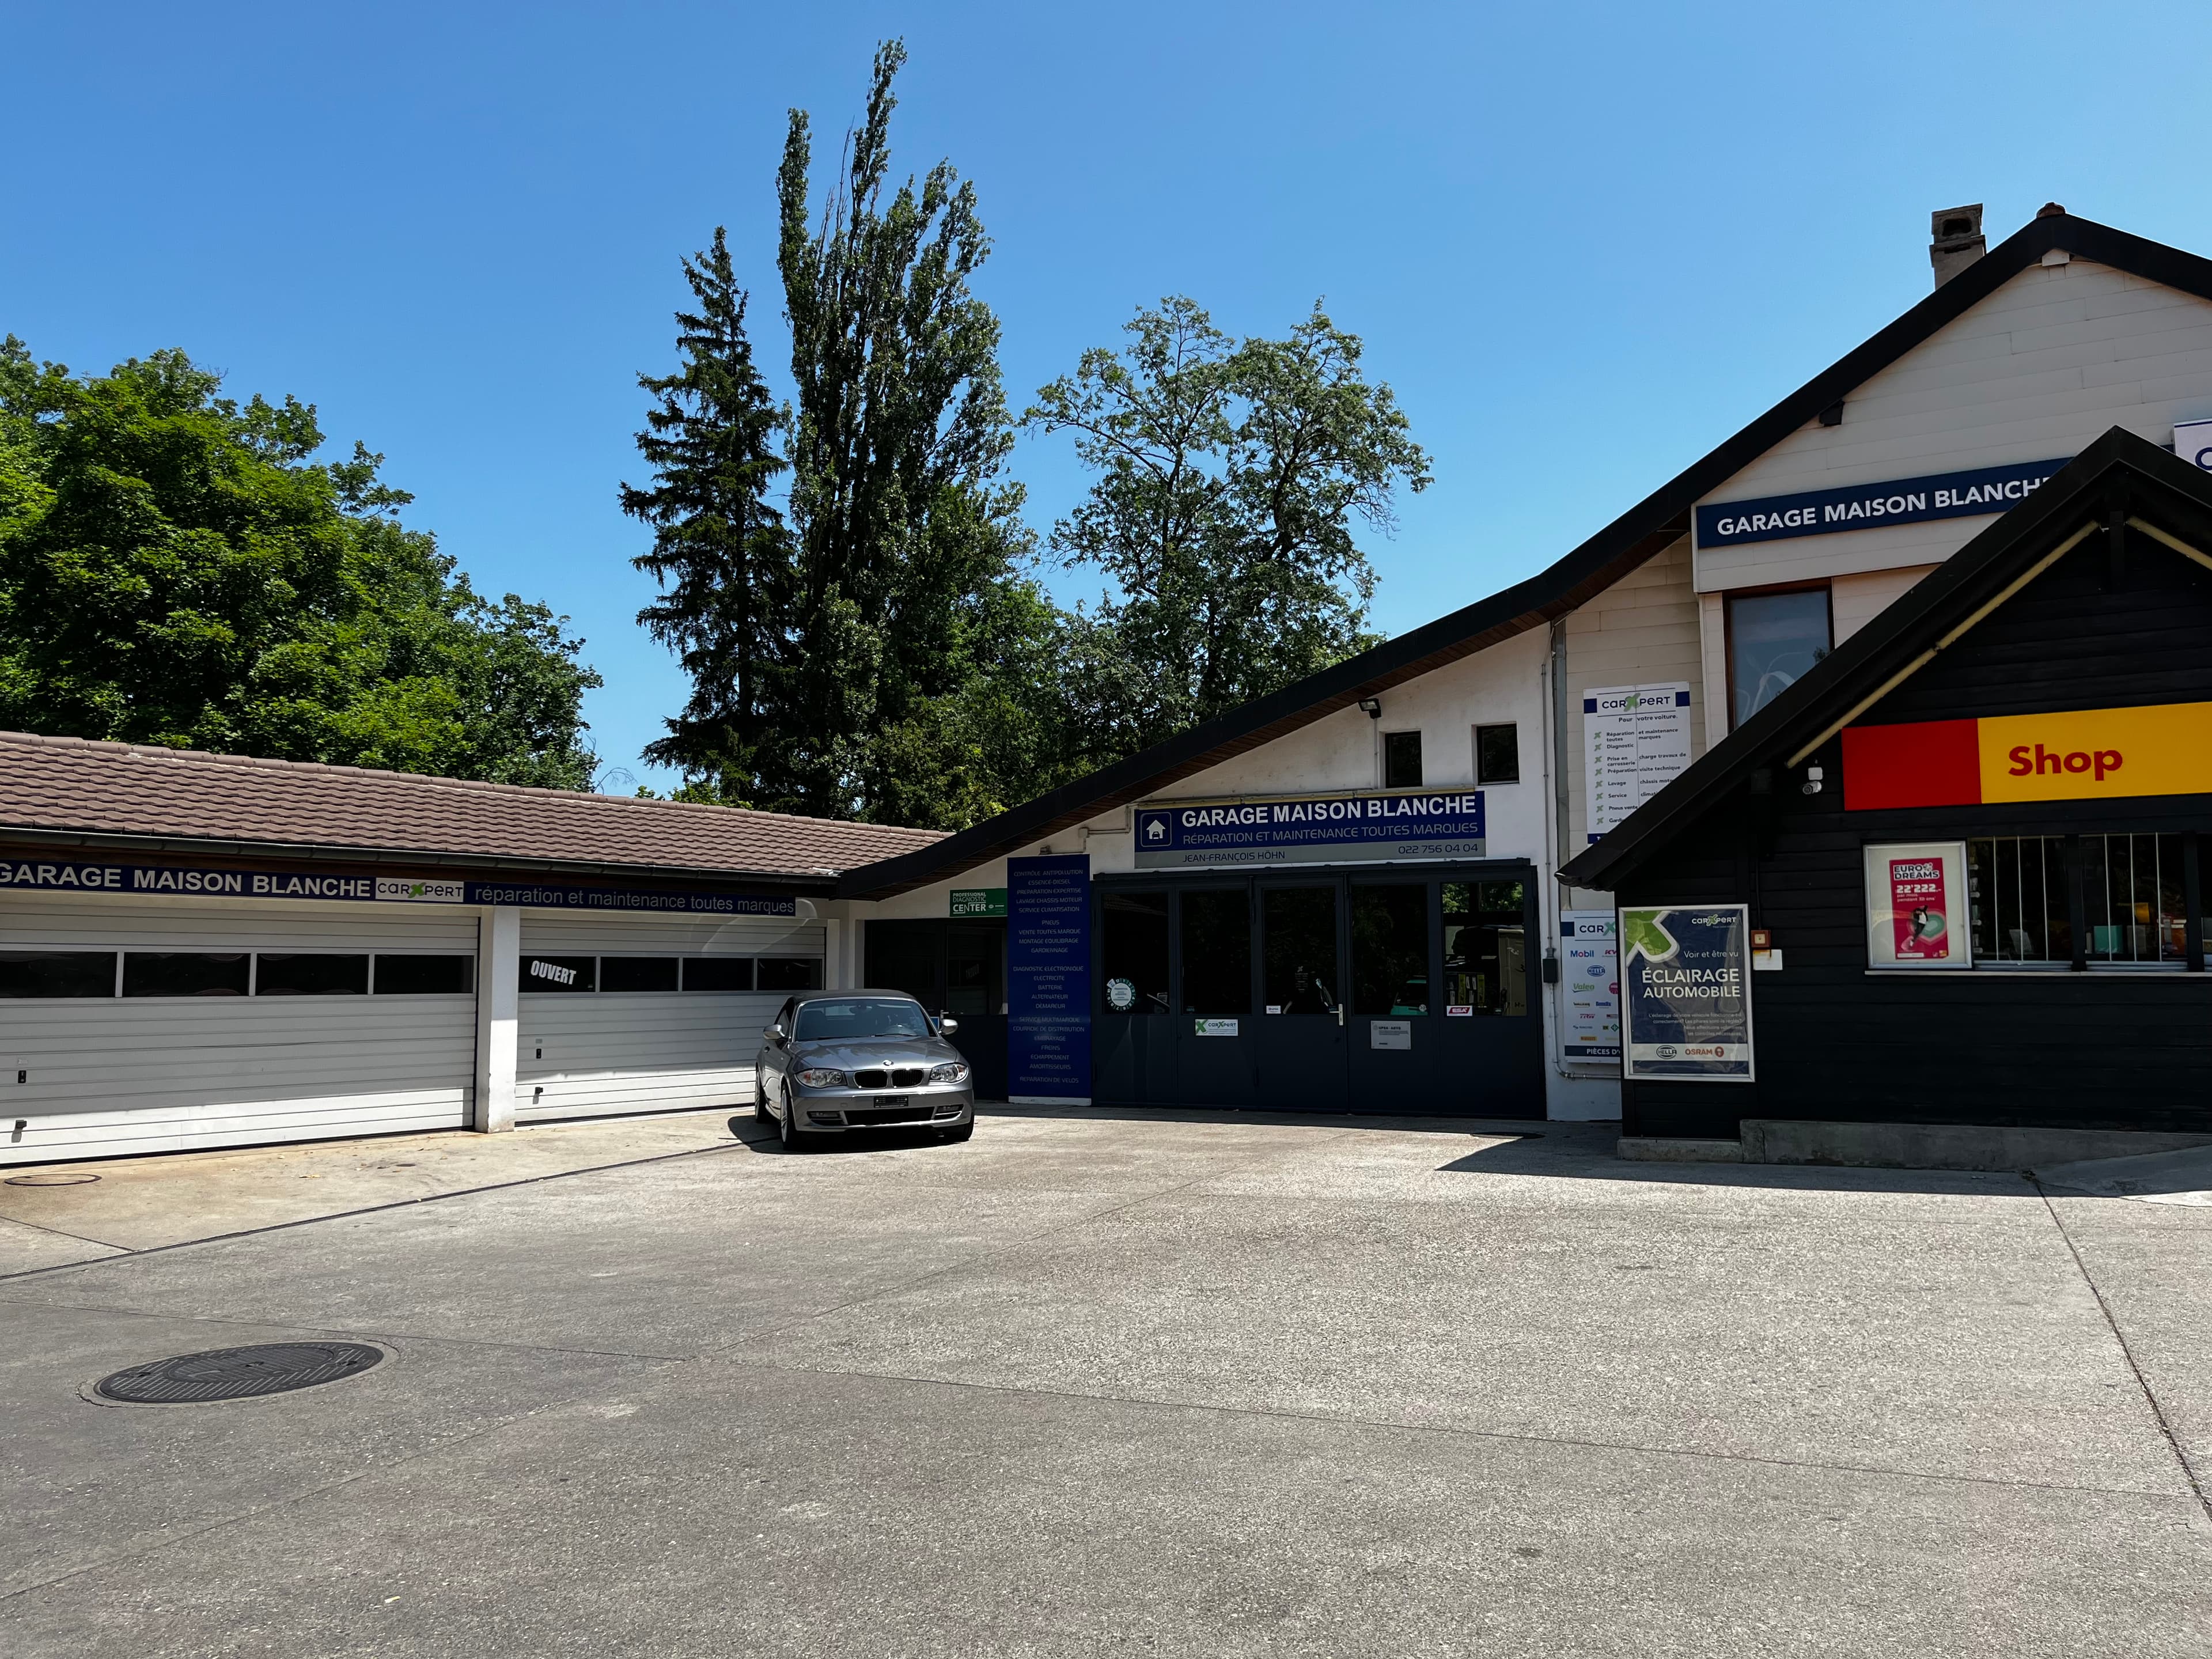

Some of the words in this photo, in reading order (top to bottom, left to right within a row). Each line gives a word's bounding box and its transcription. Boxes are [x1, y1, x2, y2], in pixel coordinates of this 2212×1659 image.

[1717, 507, 1817, 536] GARAGE
[1824, 492, 1927, 522] MAISON
[1935, 476, 2051, 508] BLANCH
[2008, 743, 2123, 782] Shop
[1181, 808, 1269, 828] GARAGE
[1273, 801, 1361, 823] MAISON
[1368, 795, 1476, 818] BLANCHE
[1183, 832, 1253, 845] RÉPARATION
[1256, 831, 1270, 841] ET
[1272, 827, 1359, 841] MAINTENANCE
[1361, 824, 1410, 837] TOUTES
[1413, 822, 1479, 835] MARQUES
[1183, 852, 1256, 863] JEAN-FRANÇOIS
[1397, 844, 1419, 855] 022
[1421, 844, 1442, 854] 756
[1445, 844, 1460, 854] 04
[1463, 843, 1479, 853] 04
[1894, 865, 1923, 873] EURO
[1894, 871, 1939, 880] DREAMS
[0, 862, 122, 888] GARAGE
[133, 869, 243, 893] MAISON
[252, 874, 372, 898] BLANCHE
[475, 885, 563, 906] réparation
[568, 890, 584, 904] et
[588, 891, 686, 909] maintenance
[690, 895, 733, 911] toutes
[737, 900, 794, 915] marques
[952, 903, 987, 913] CENTER
[1683, 950, 1699, 959] Voir
[1712, 950, 1727, 958] être
[530, 960, 577, 986] OUVERT
[1642, 967, 1740, 984] ÉCLAIRAGE
[1643, 986, 1741, 999] AUTOMOBILE
